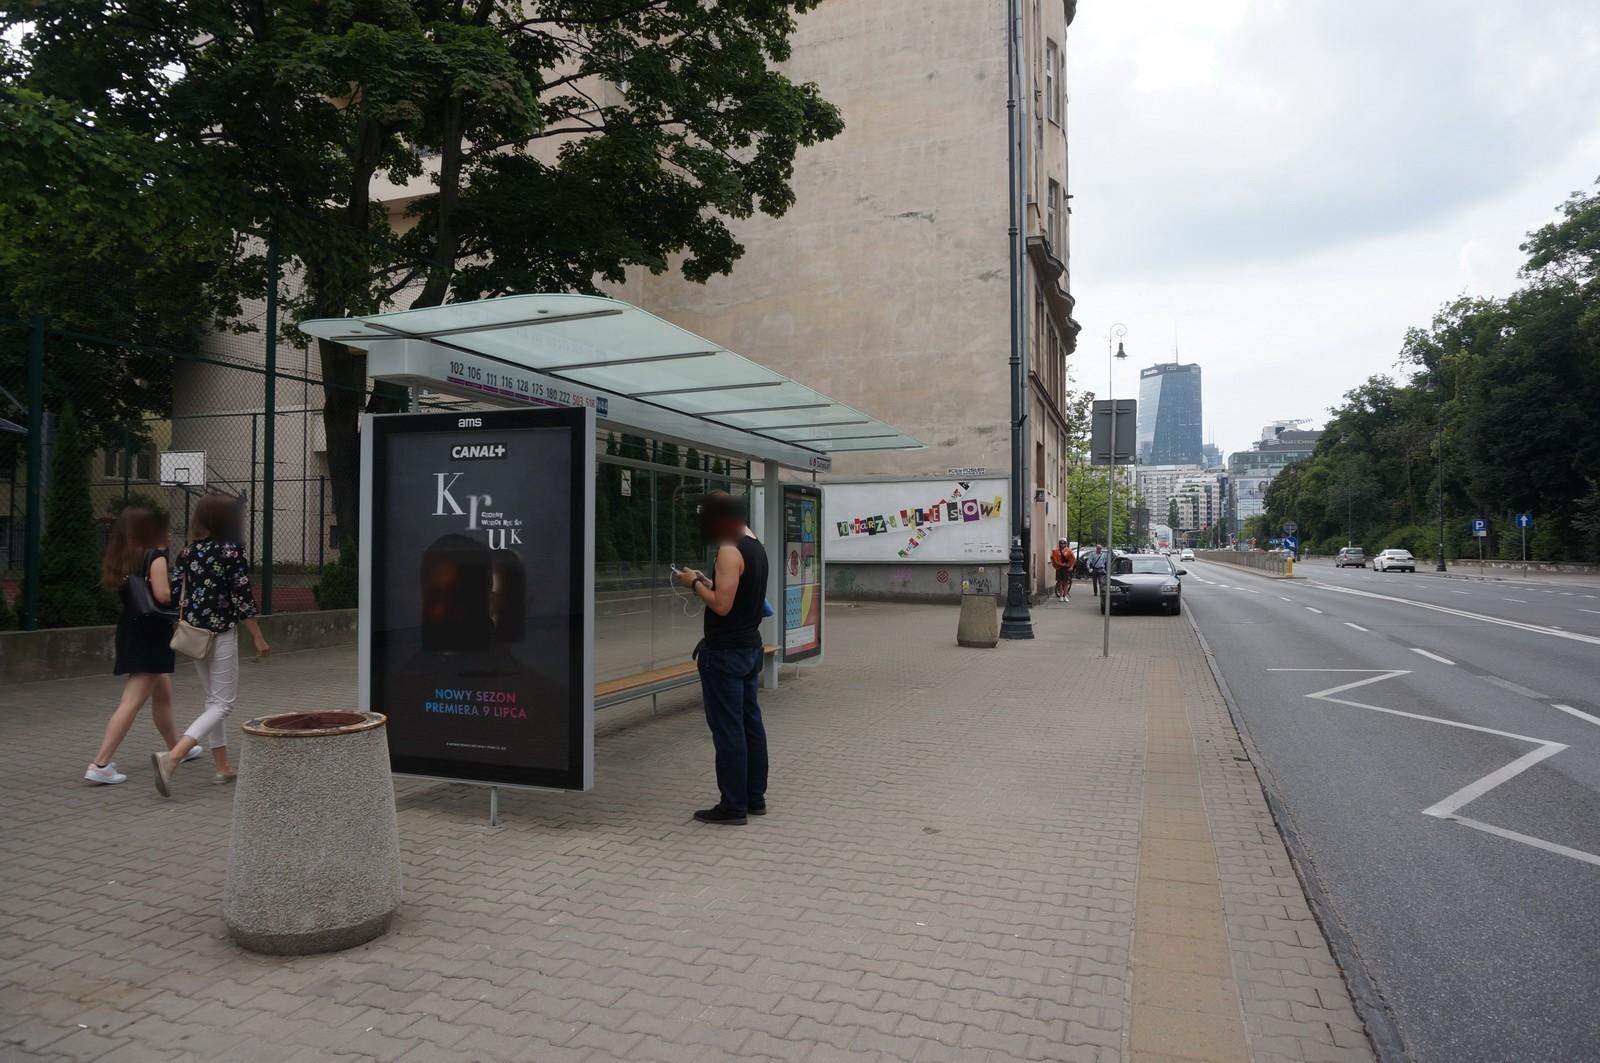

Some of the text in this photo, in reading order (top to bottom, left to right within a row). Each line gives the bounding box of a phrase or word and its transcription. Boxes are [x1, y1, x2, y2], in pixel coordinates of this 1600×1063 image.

[450, 361, 464, 376] 102
[468, 366, 481, 381] 106
[487, 373, 497, 387] 111
[502, 375, 513, 389] 116
[517, 379, 529, 393] 128
[532, 383, 544, 396] 175
[546, 387, 558, 401] 180
[559, 390, 571, 404] 222
[458, 417, 483, 428] ams
[451, 444, 506, 459] CANAL+
[435, 688, 516, 704] NOWY SEZON
[425, 702, 528, 720] PREMIERA 9 LIPCA
